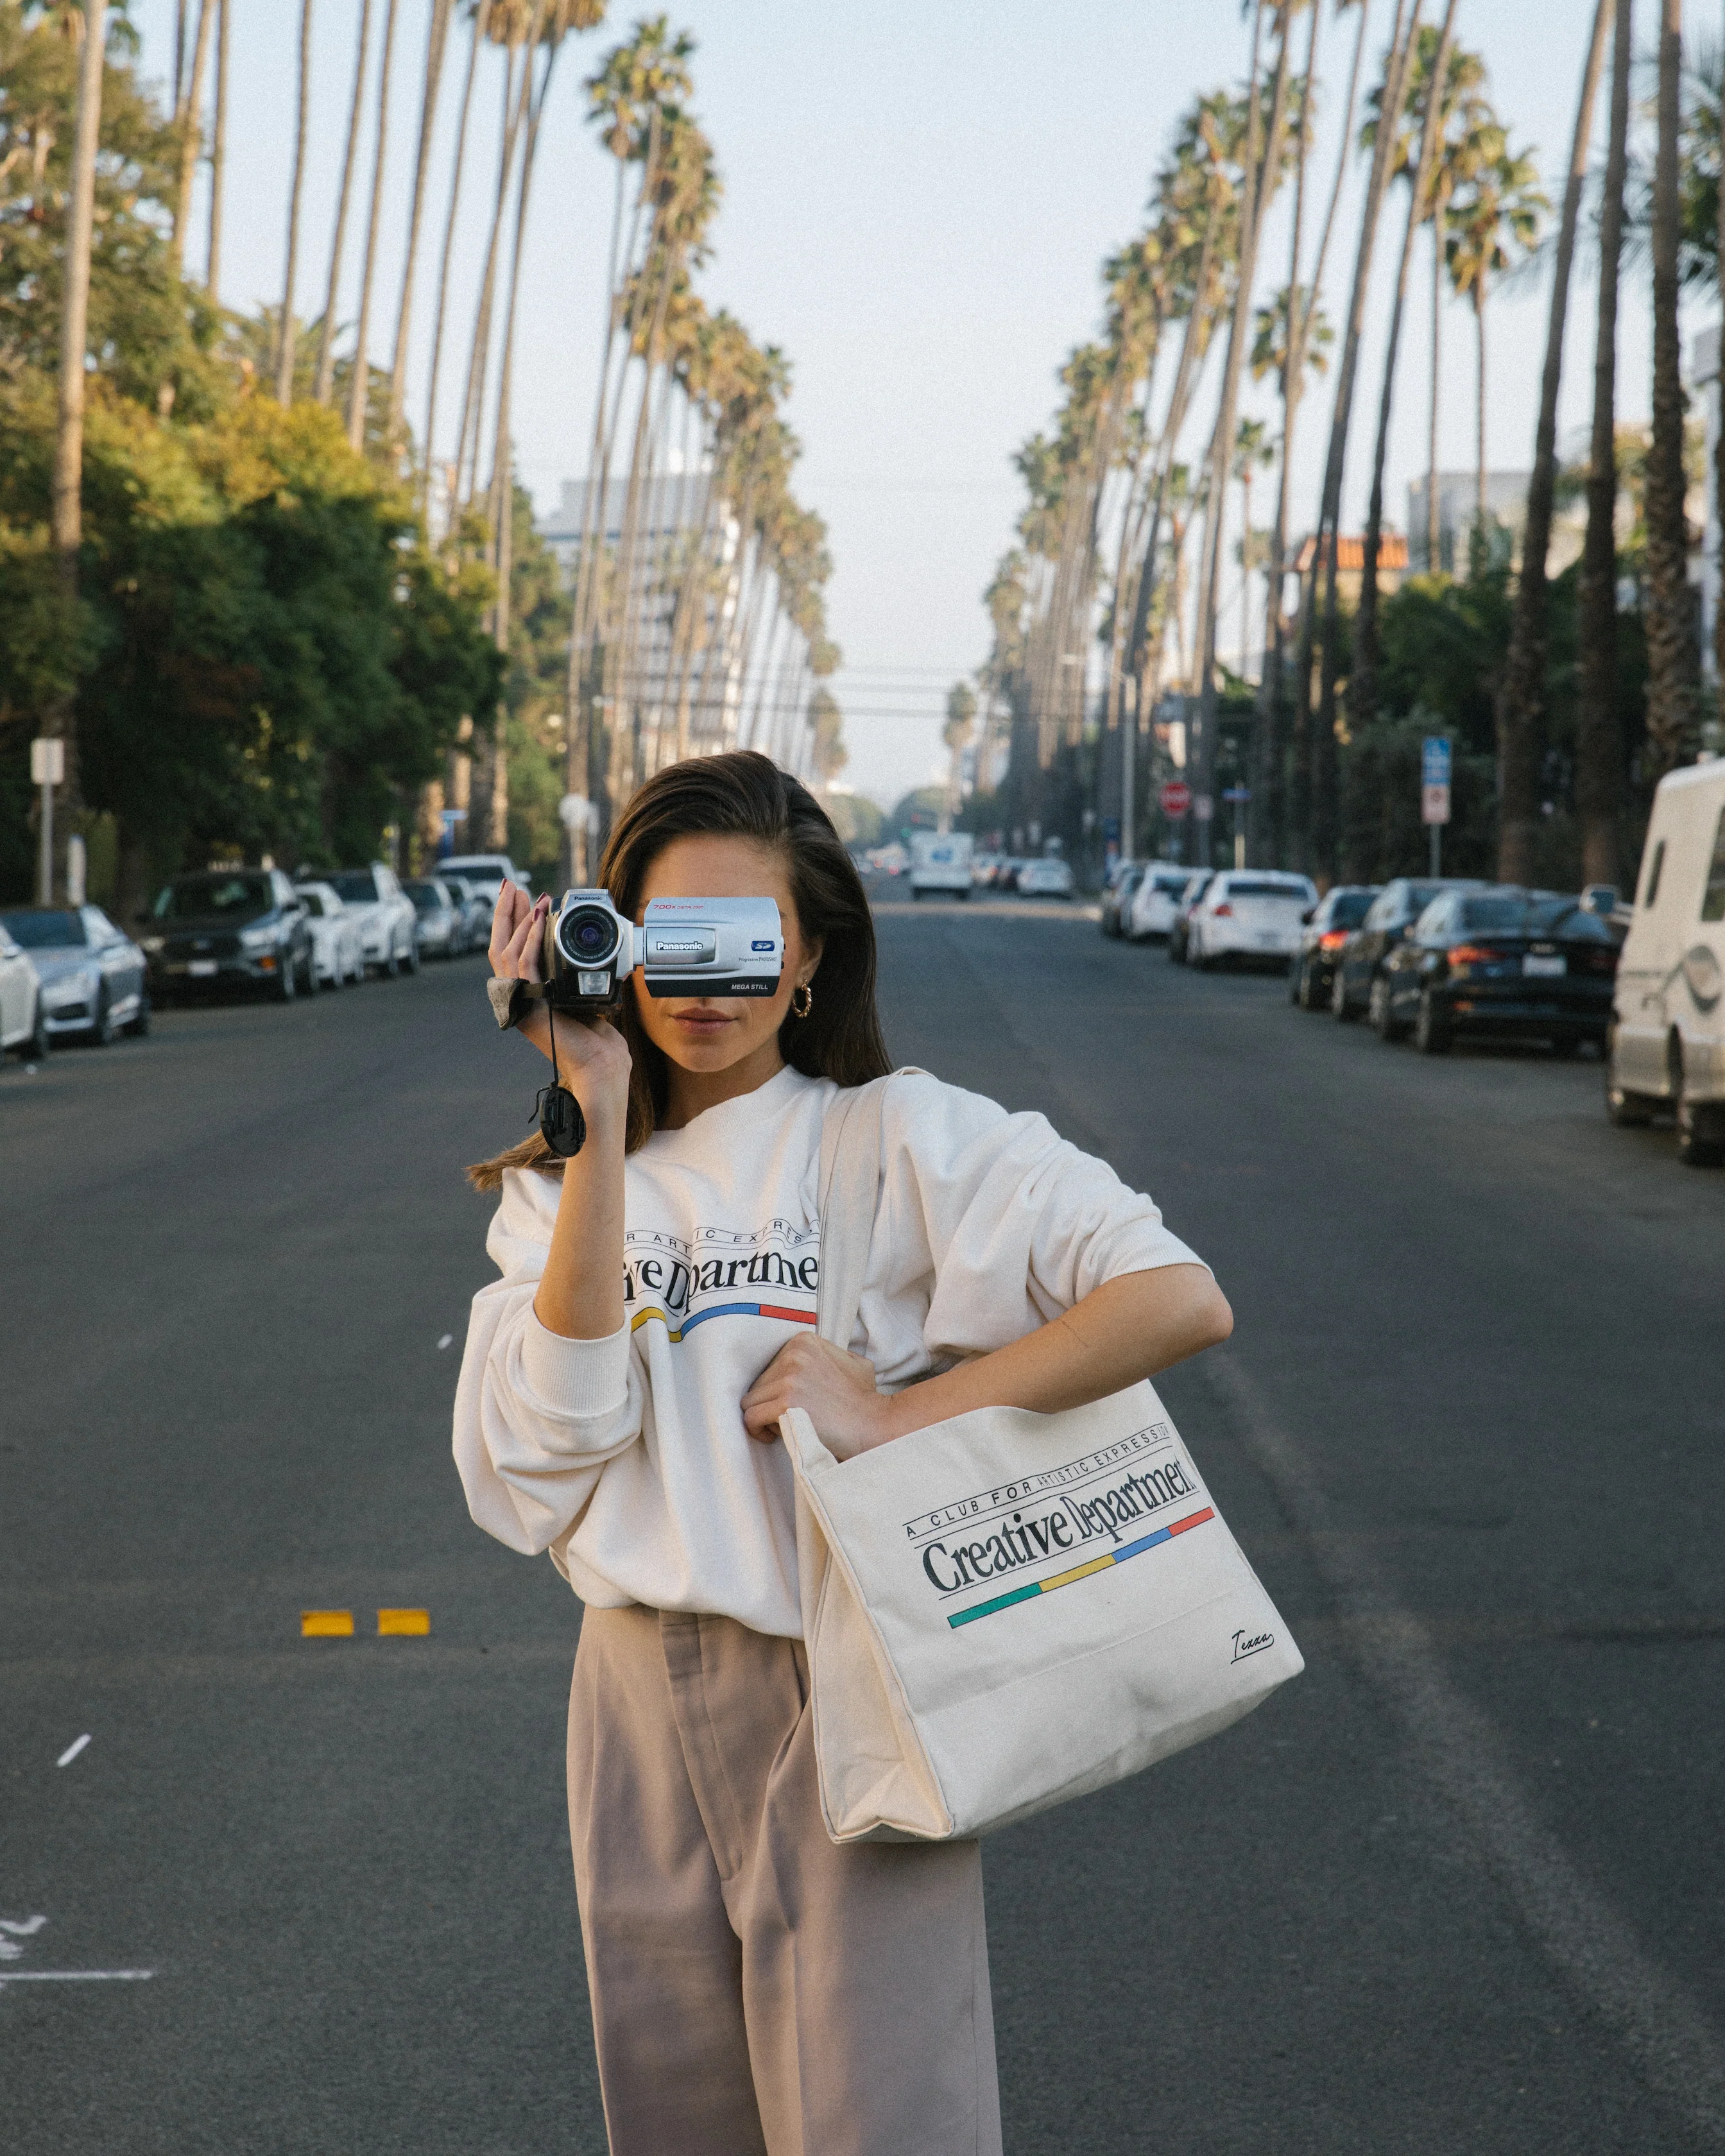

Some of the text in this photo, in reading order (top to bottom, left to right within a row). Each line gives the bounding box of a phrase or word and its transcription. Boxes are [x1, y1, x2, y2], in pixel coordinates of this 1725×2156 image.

[657, 941, 703, 950] Panasonic
[907, 1526, 916, 1537] A
[931, 1500, 979, 1527] CLUB
[991, 1482, 1032, 1505] FOR
[1036, 1462, 1088, 1487] ARTISTIC
[923, 1512, 1073, 1592] Creative
